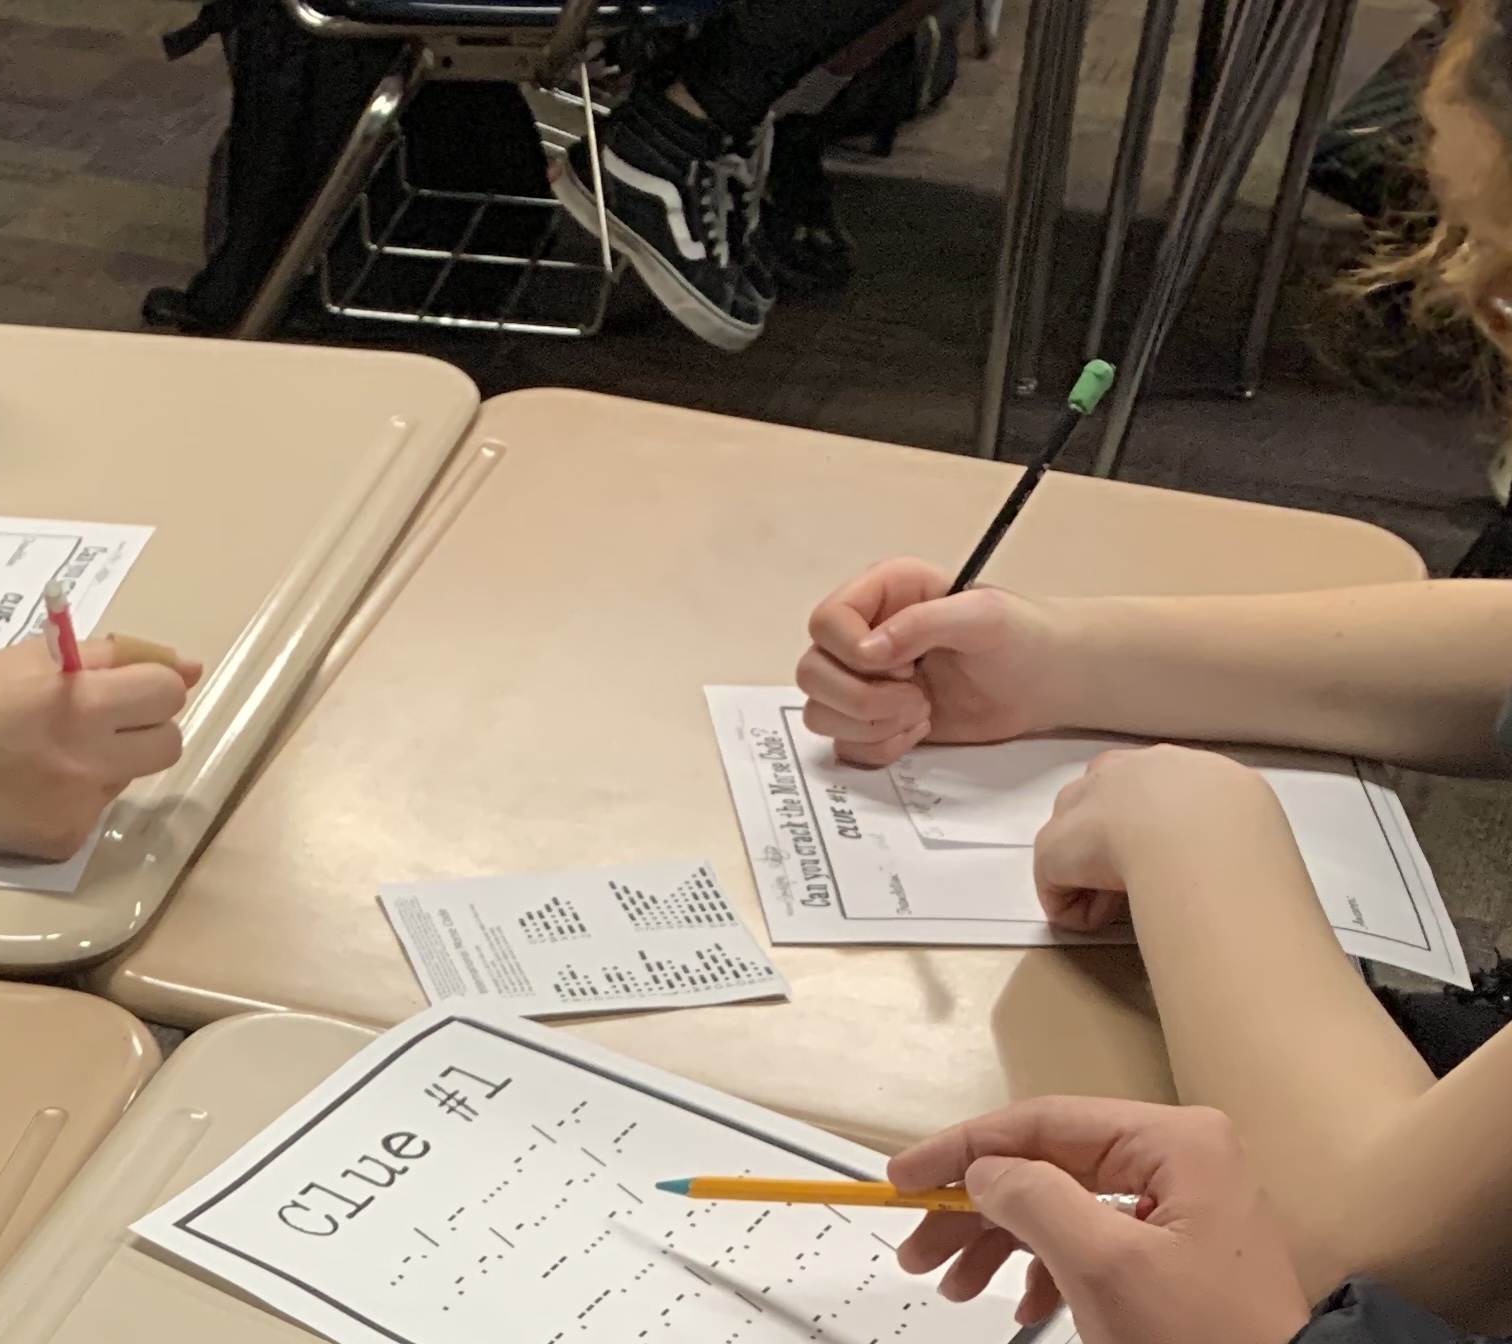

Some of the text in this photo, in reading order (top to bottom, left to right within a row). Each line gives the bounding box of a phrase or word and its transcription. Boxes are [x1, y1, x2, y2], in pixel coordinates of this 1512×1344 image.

[751, 728, 831, 907] Can you crack the Morse Code?
[831, 807, 862, 839] CLUE
[278, 1065, 512, 1236] Clue #1
